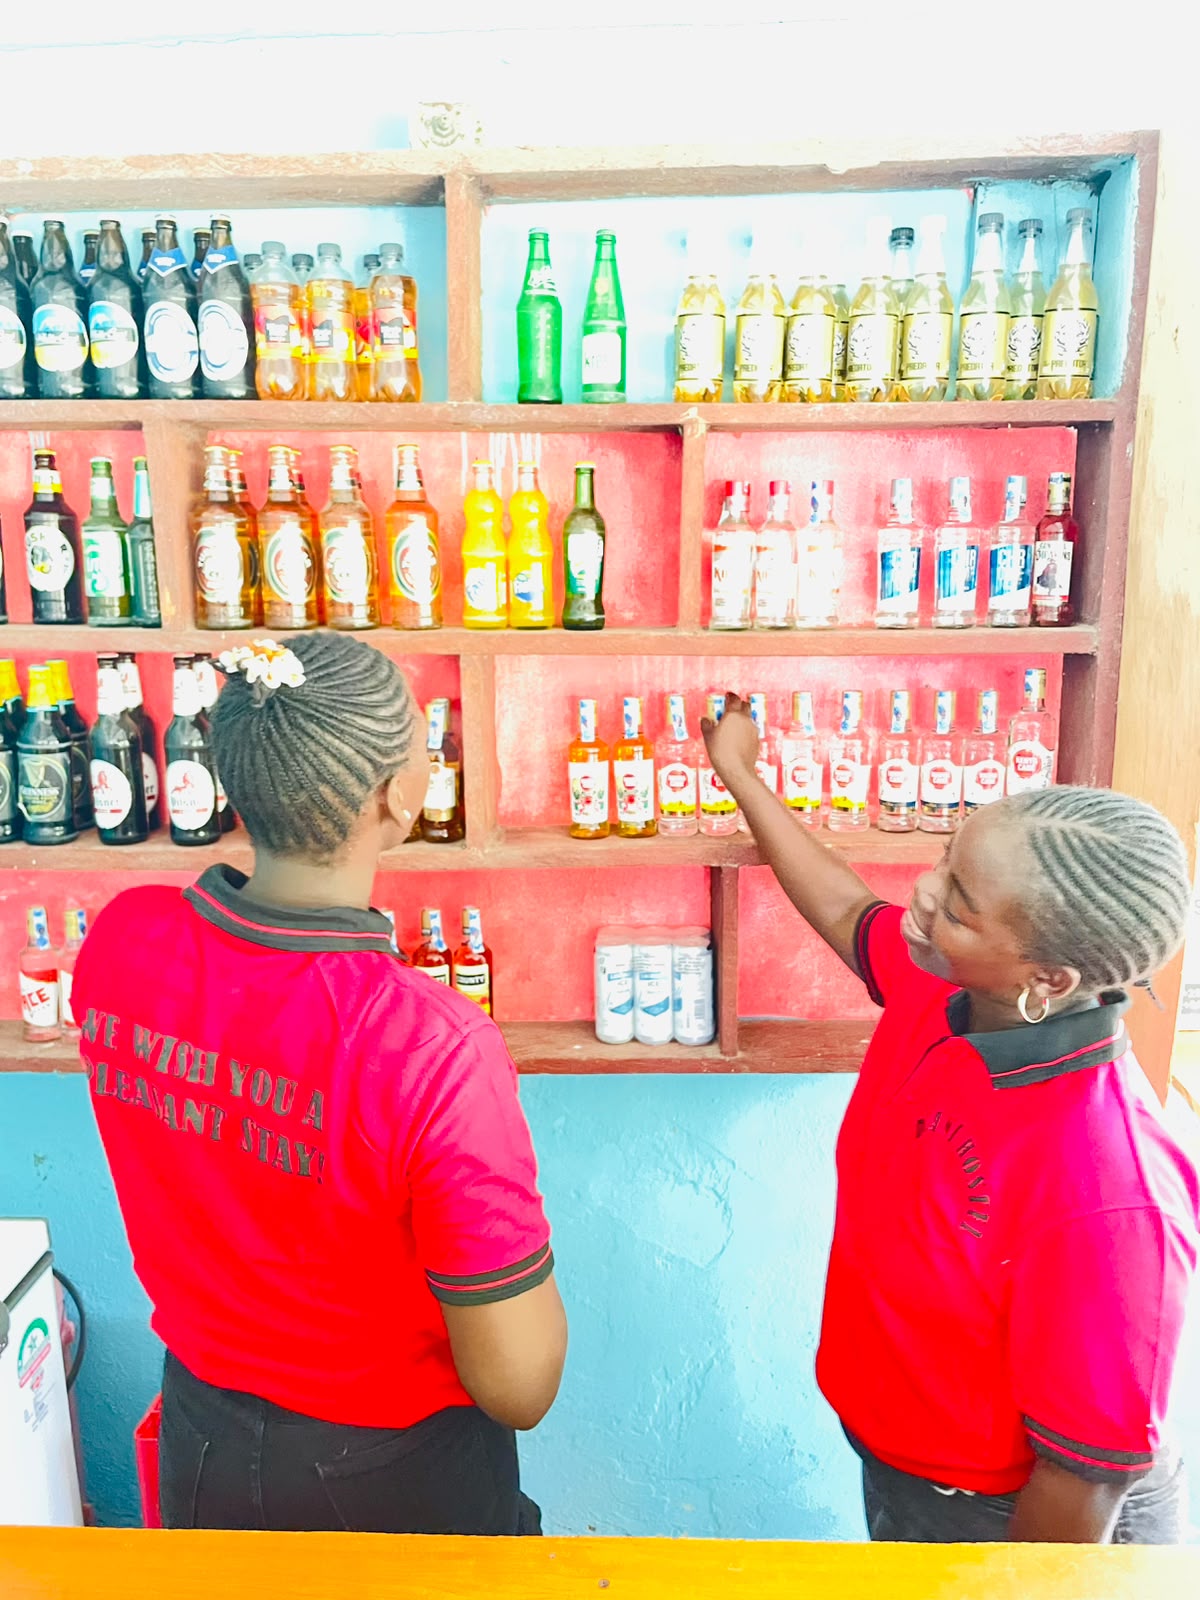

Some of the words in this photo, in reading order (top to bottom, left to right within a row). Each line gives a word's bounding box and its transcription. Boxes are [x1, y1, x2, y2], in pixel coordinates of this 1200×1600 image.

[906, 362, 942, 371] PREDAR
[1050, 359, 1087, 371] PRETOR
[133, 1023, 220, 1087] WISH
[229, 1058, 298, 1117] YOU
[302, 1089, 325, 1132] A
[241, 1115, 326, 1185] STAY!
